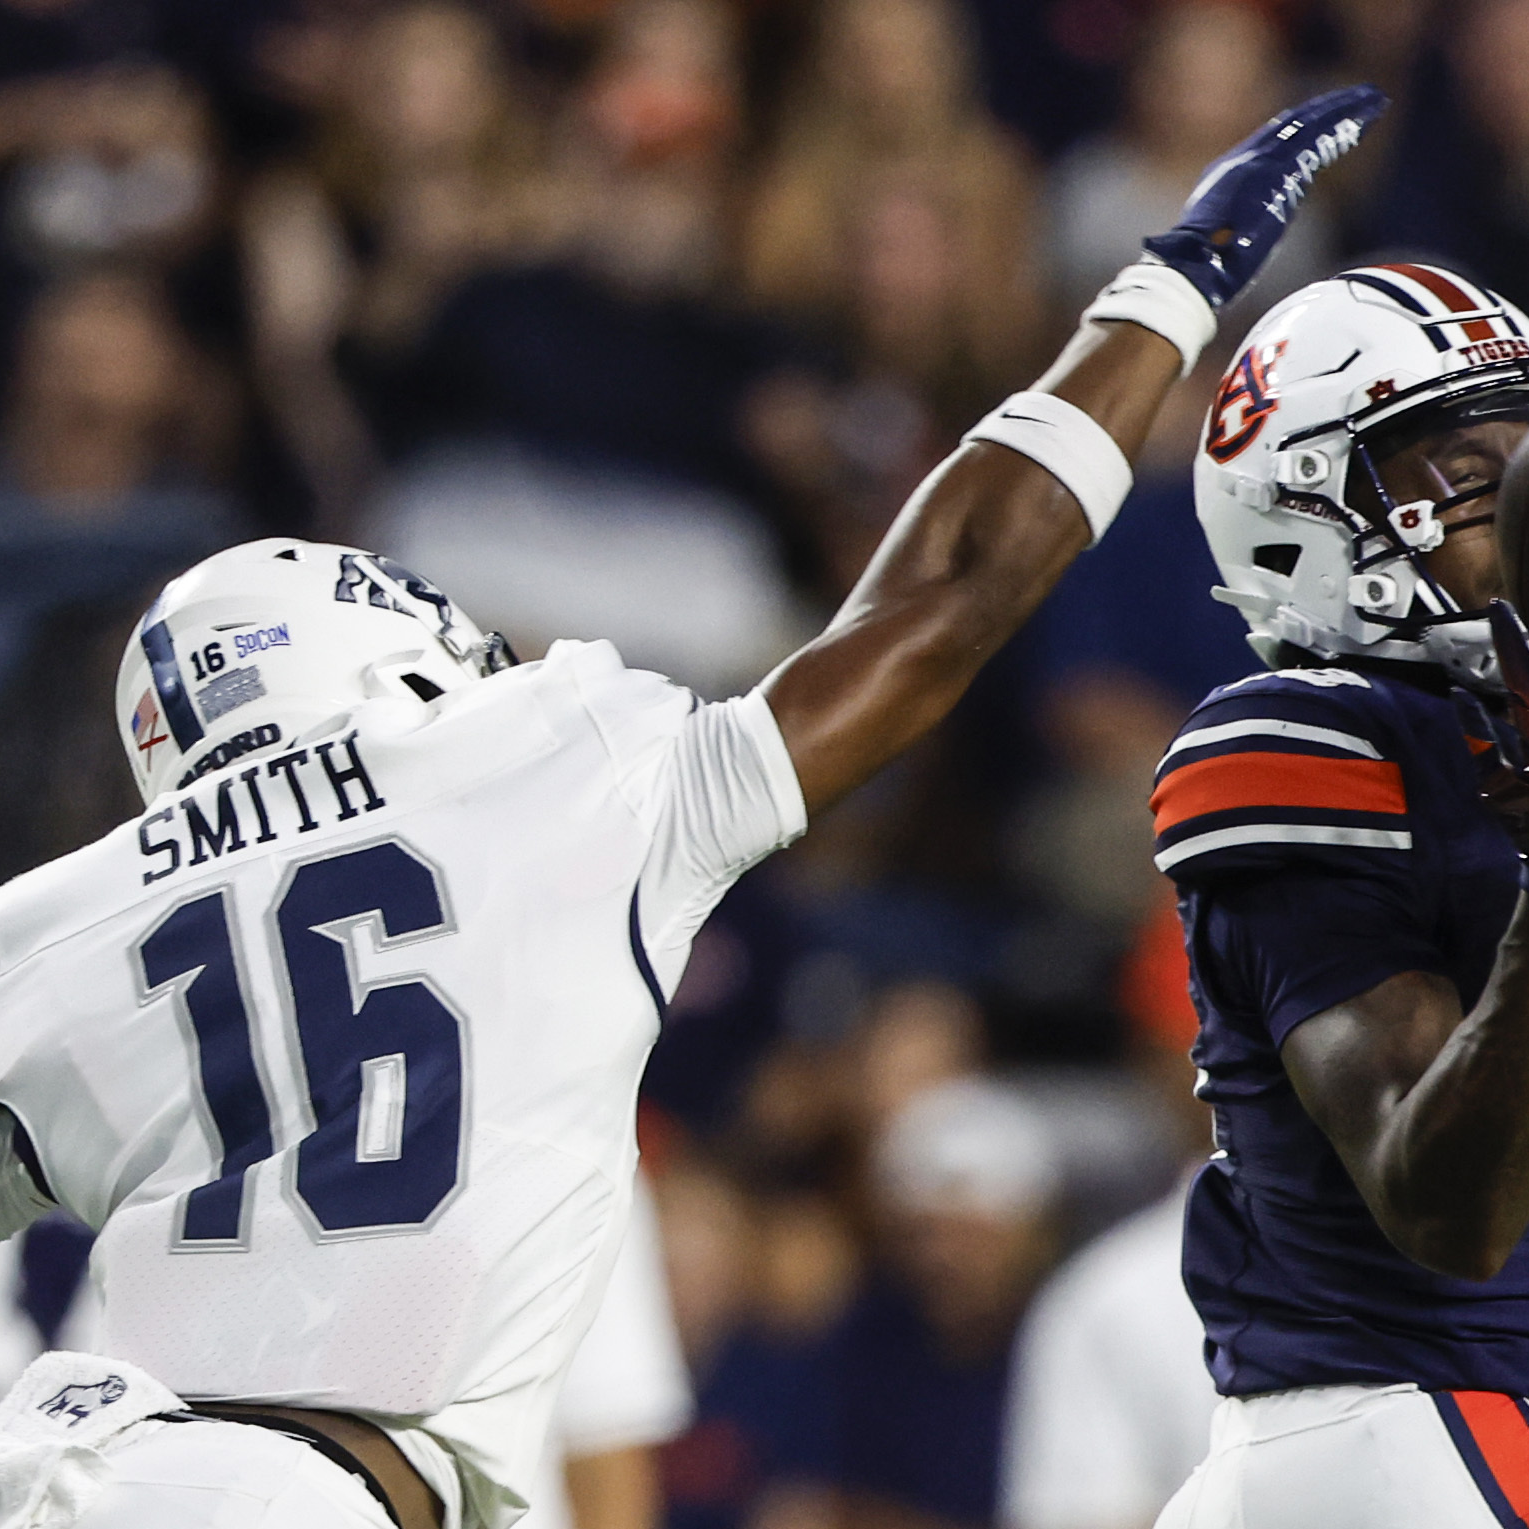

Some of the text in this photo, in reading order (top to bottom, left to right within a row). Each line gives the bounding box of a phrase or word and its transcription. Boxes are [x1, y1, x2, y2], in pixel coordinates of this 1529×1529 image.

[190, 641, 226, 681] 16
[139, 728, 386, 886] SMITH
[126, 832, 471, 1255] 16
